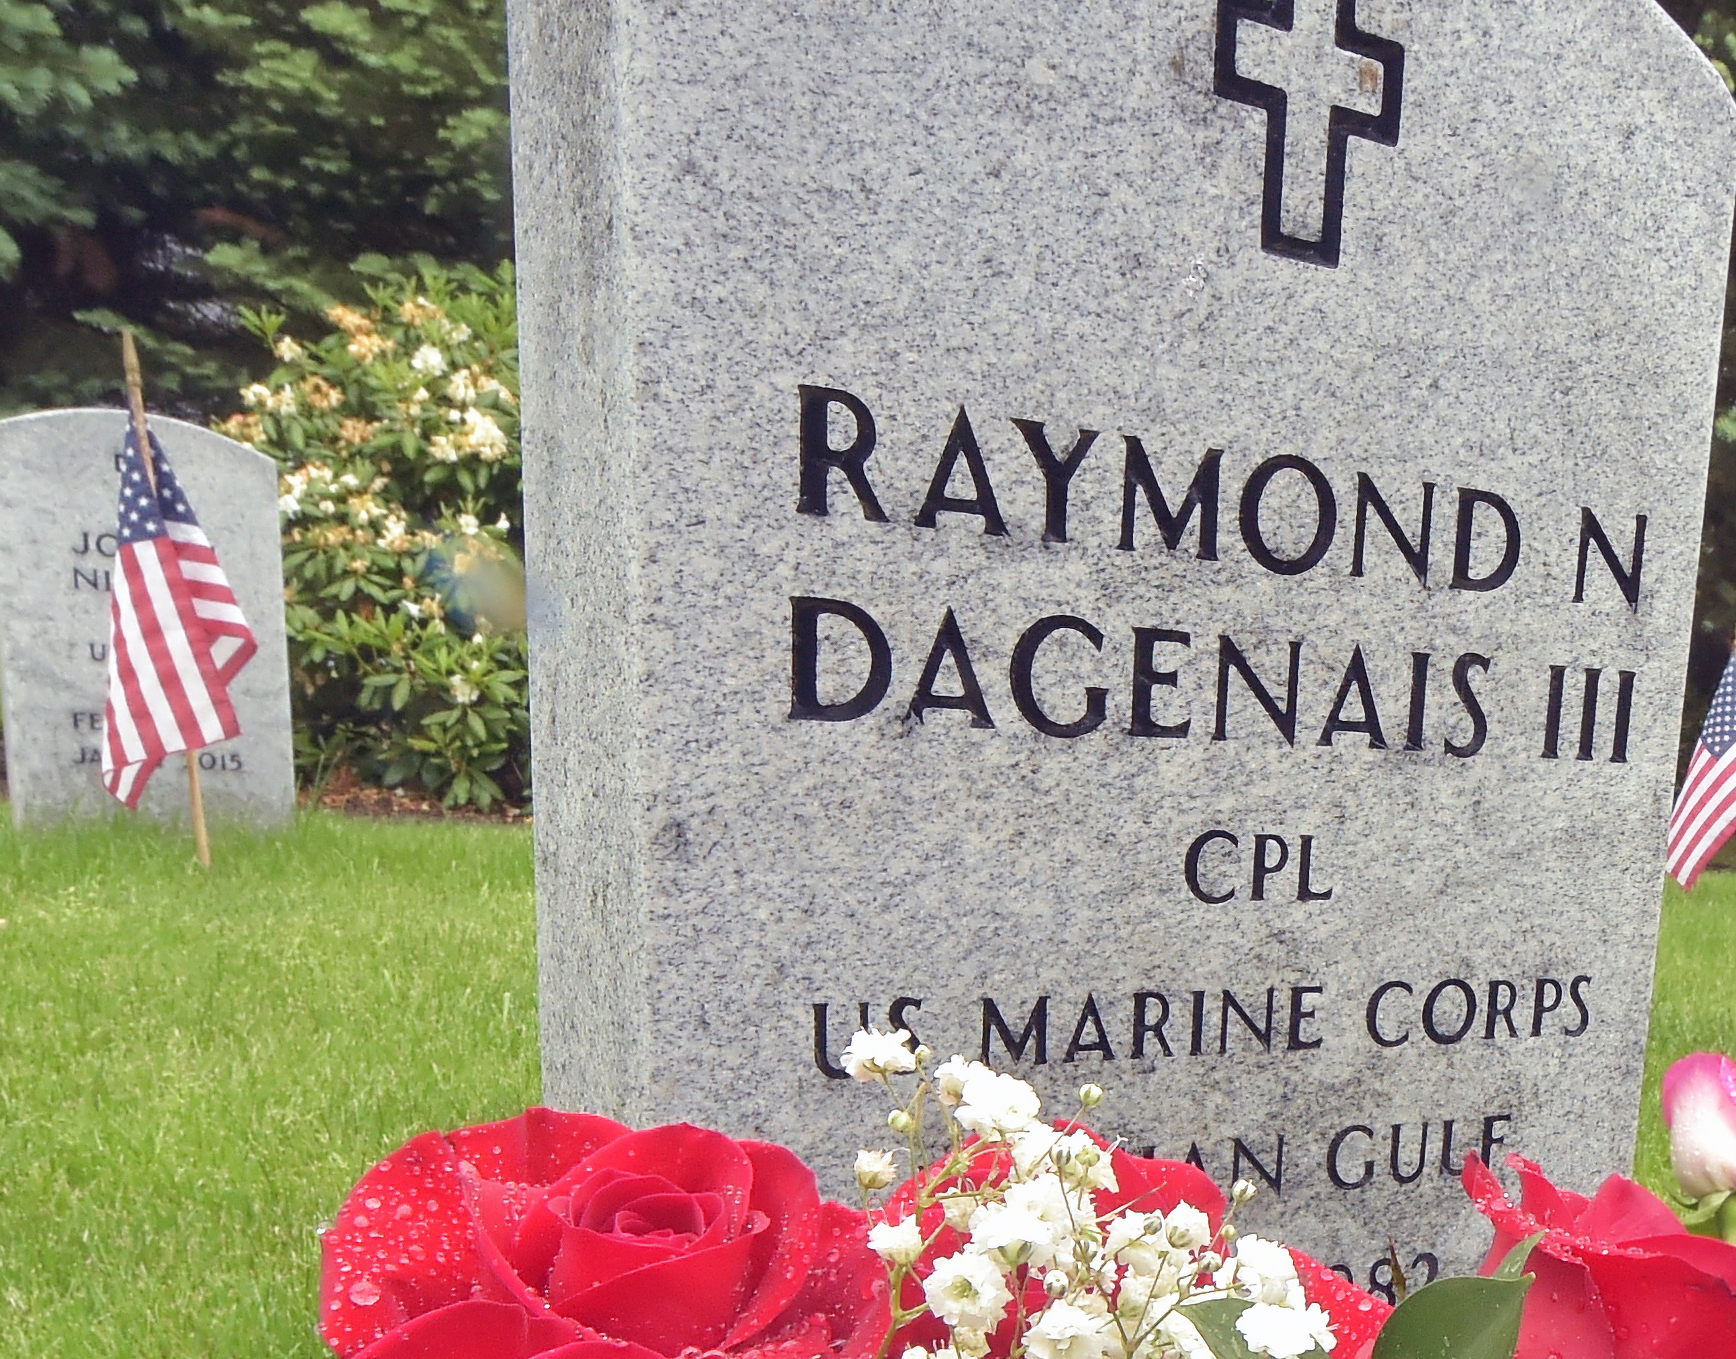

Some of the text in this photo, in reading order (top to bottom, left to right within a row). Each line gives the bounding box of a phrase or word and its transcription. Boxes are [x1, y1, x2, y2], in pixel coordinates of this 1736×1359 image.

[796, 384, 1648, 614] RAYMOND N
[787, 595, 1638, 763] DAGENAIS III
[1184, 828, 1334, 905] CPL
[812, 974, 1594, 1079] US MARINE CORPS
[1326, 1113, 1512, 1191] GULF
